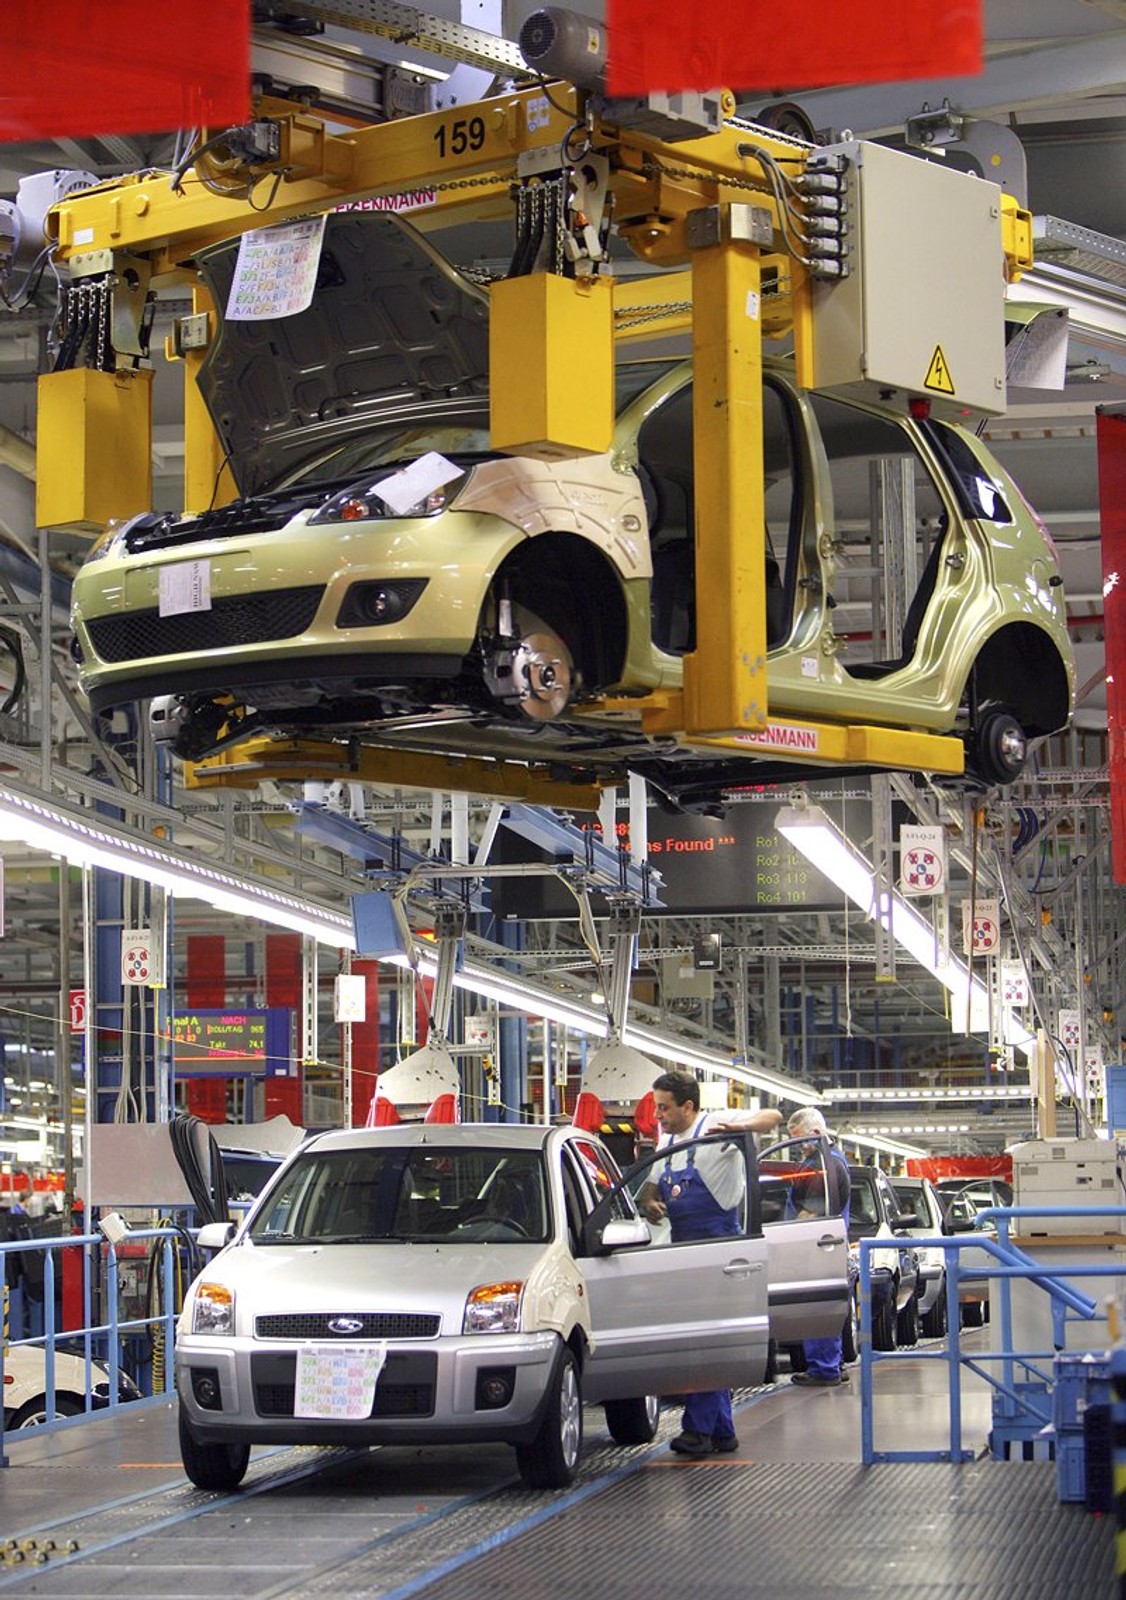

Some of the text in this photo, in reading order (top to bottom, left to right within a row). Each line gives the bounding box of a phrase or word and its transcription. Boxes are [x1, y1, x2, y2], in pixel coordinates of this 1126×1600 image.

[434, 117, 485, 158] 159
[737, 727, 815, 749] ENMANN
[666, 838, 714, 852] Found
[756, 836, 778, 848] Ro1
[757, 855, 779, 866] Ro2
[757, 873, 780, 885] Ro3
[757, 891, 781, 903] Ro4
[166, 1016, 199, 1026] Fnal A
[221, 1016, 246, 1025] NACH
